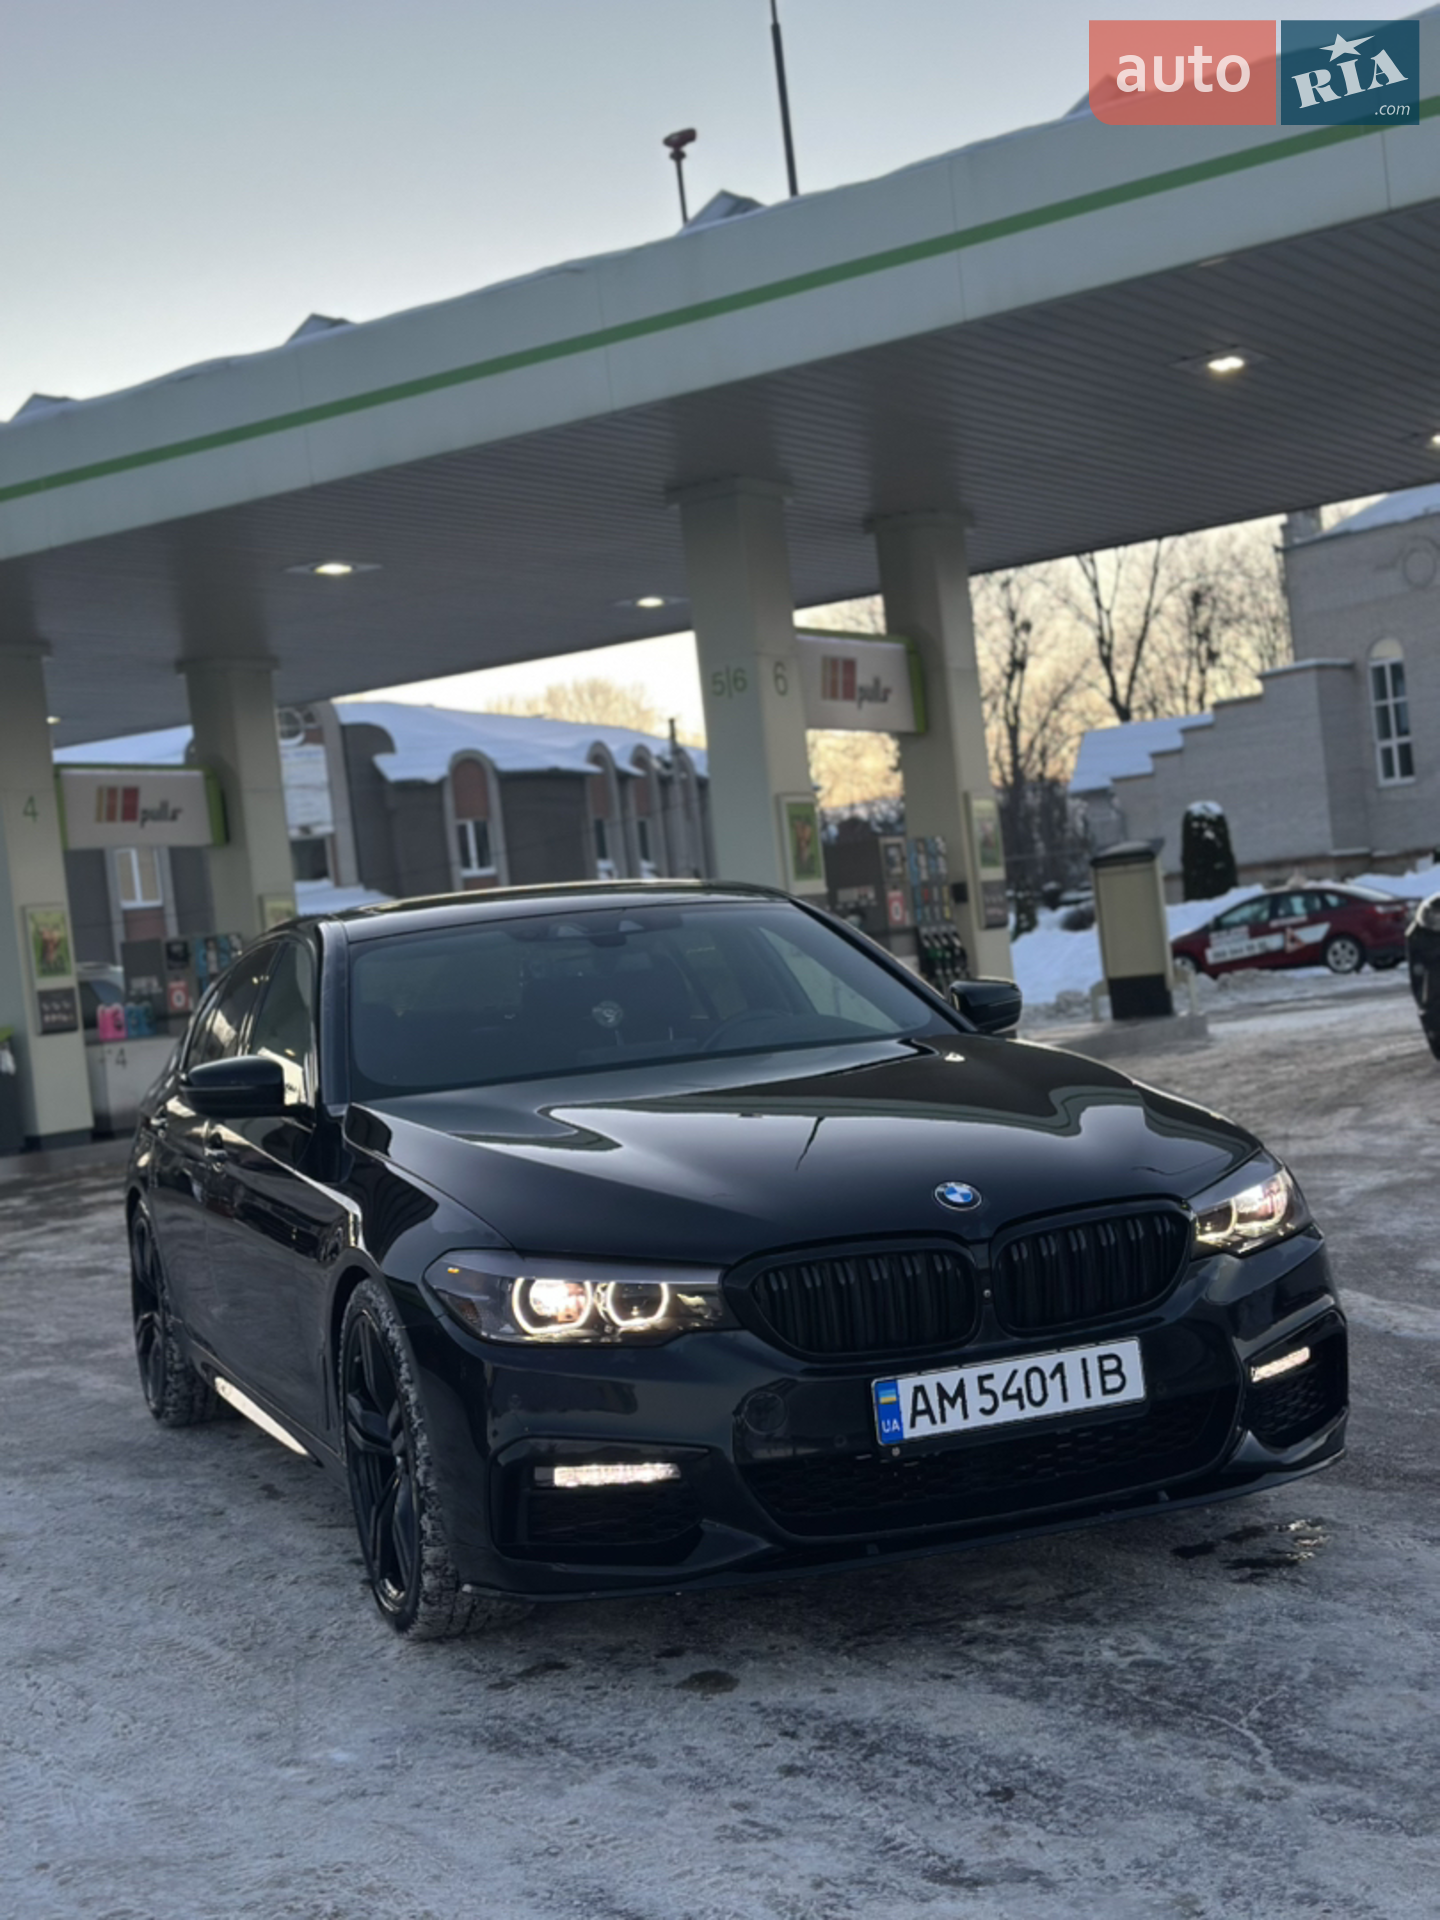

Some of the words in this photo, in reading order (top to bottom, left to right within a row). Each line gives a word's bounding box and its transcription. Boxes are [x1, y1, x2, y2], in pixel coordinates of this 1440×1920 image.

[773, 661, 788, 696] 6
[23, 795, 39, 823] 4
[909, 1377, 970, 1430] AM
[977, 1361, 1069, 1416] 5401
[1081, 1353, 1127, 1399] IB
[881, 1419, 900, 1434] UA
